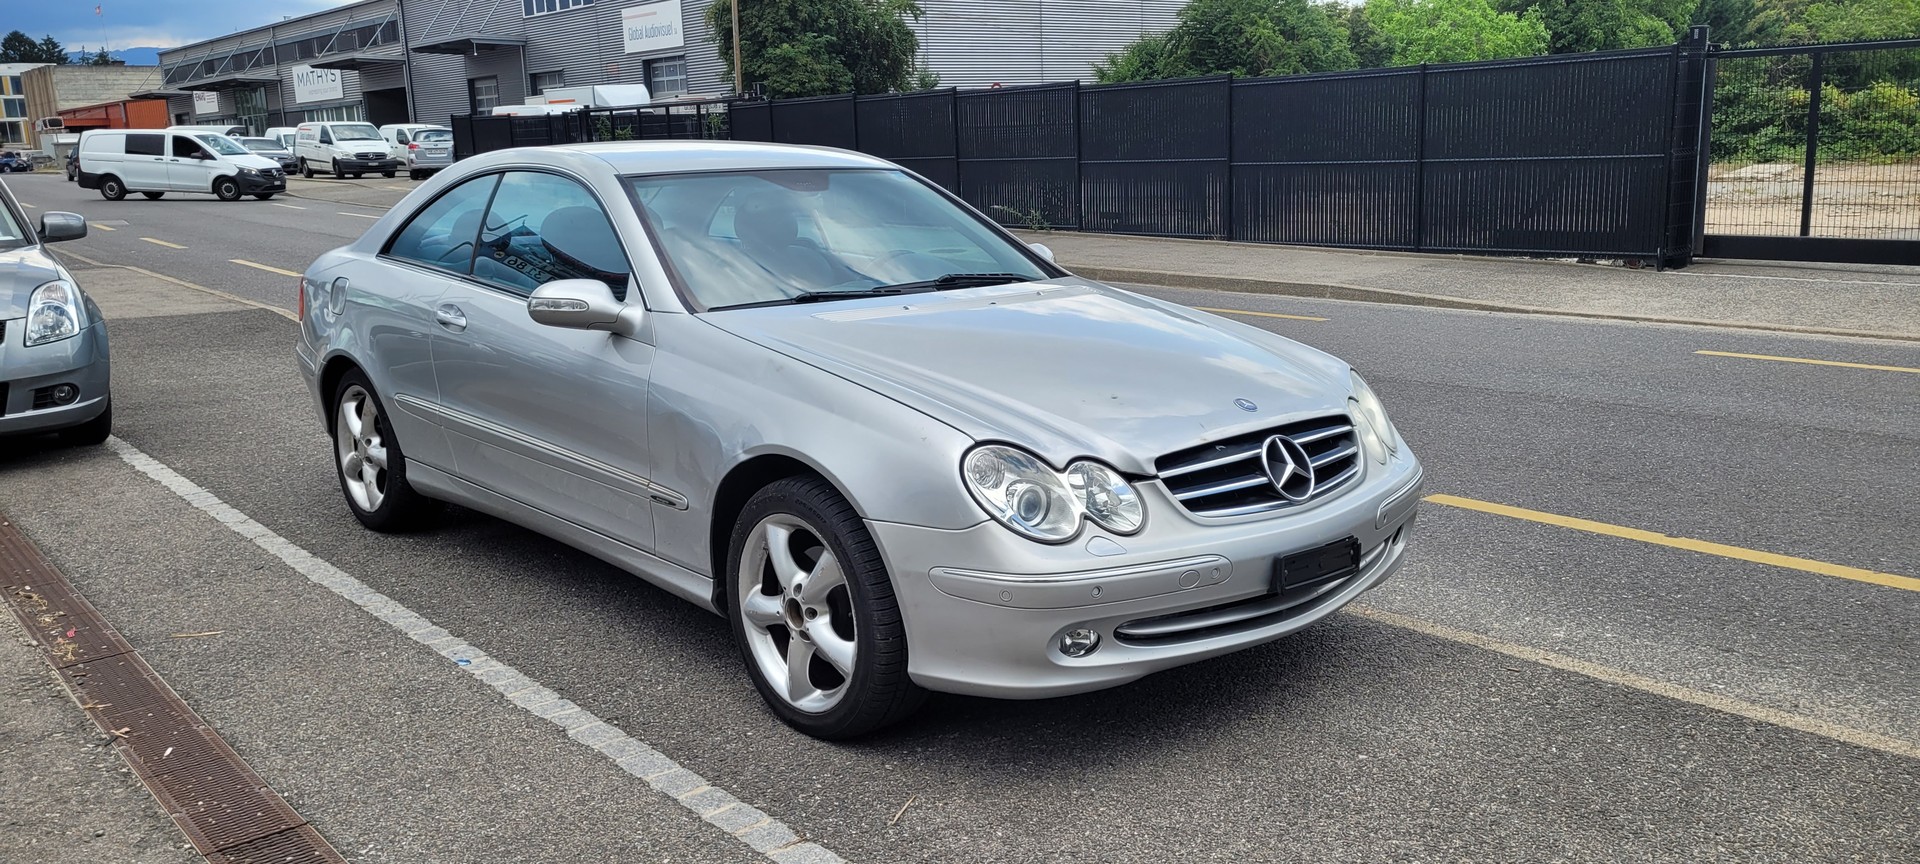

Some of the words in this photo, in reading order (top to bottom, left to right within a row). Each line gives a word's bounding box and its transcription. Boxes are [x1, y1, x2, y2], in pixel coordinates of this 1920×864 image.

[628, 24, 644, 41] Global
[645, 21, 673, 39] Audiovisuel
[296, 69, 337, 88] MATHYS
